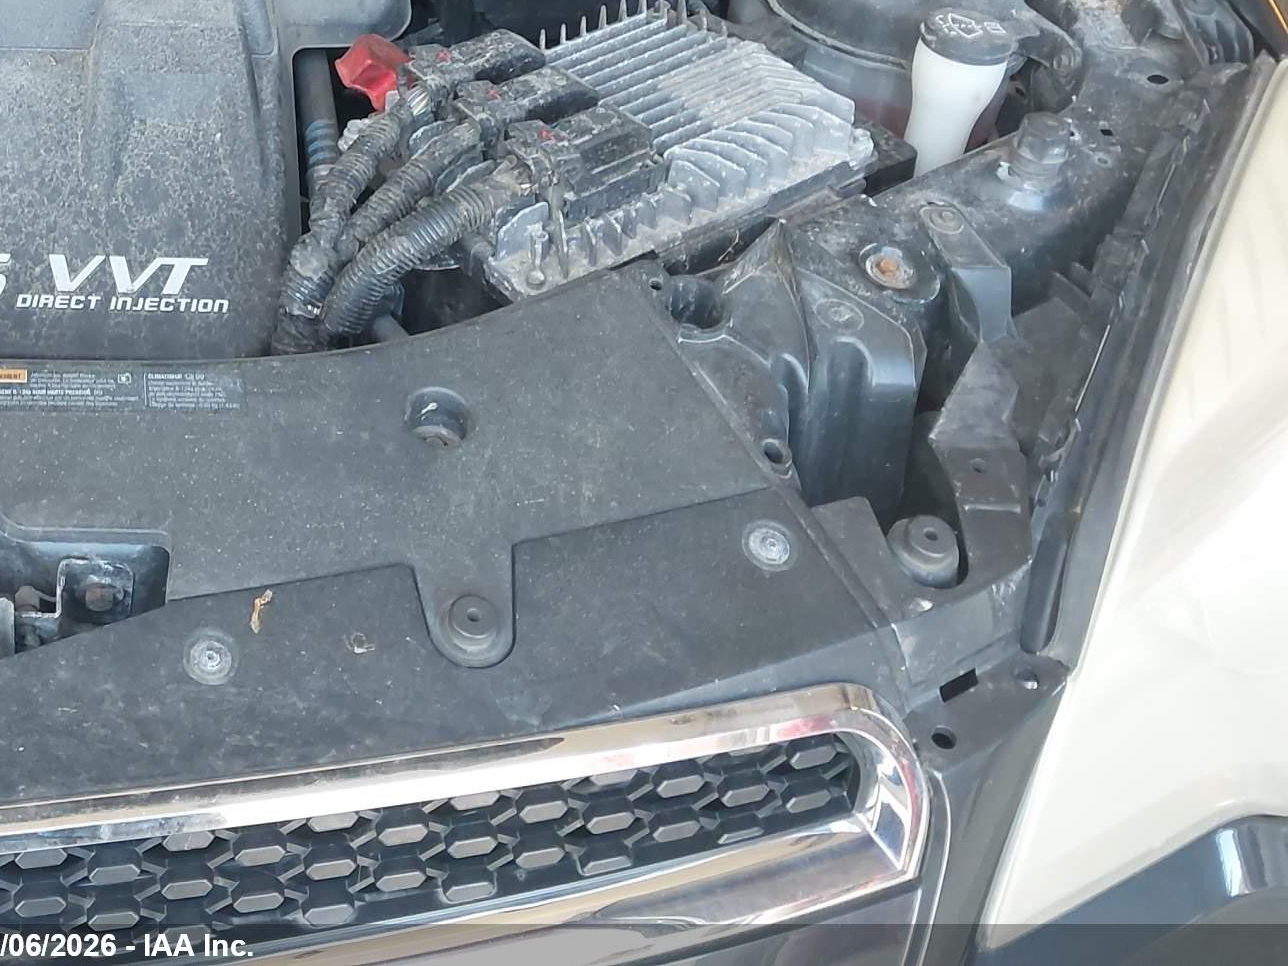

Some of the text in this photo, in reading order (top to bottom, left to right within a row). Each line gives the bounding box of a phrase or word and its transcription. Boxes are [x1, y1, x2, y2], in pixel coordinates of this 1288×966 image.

[48, 254, 209, 295] VVT
[15, 294, 229, 314] DIRECT INJECTION
